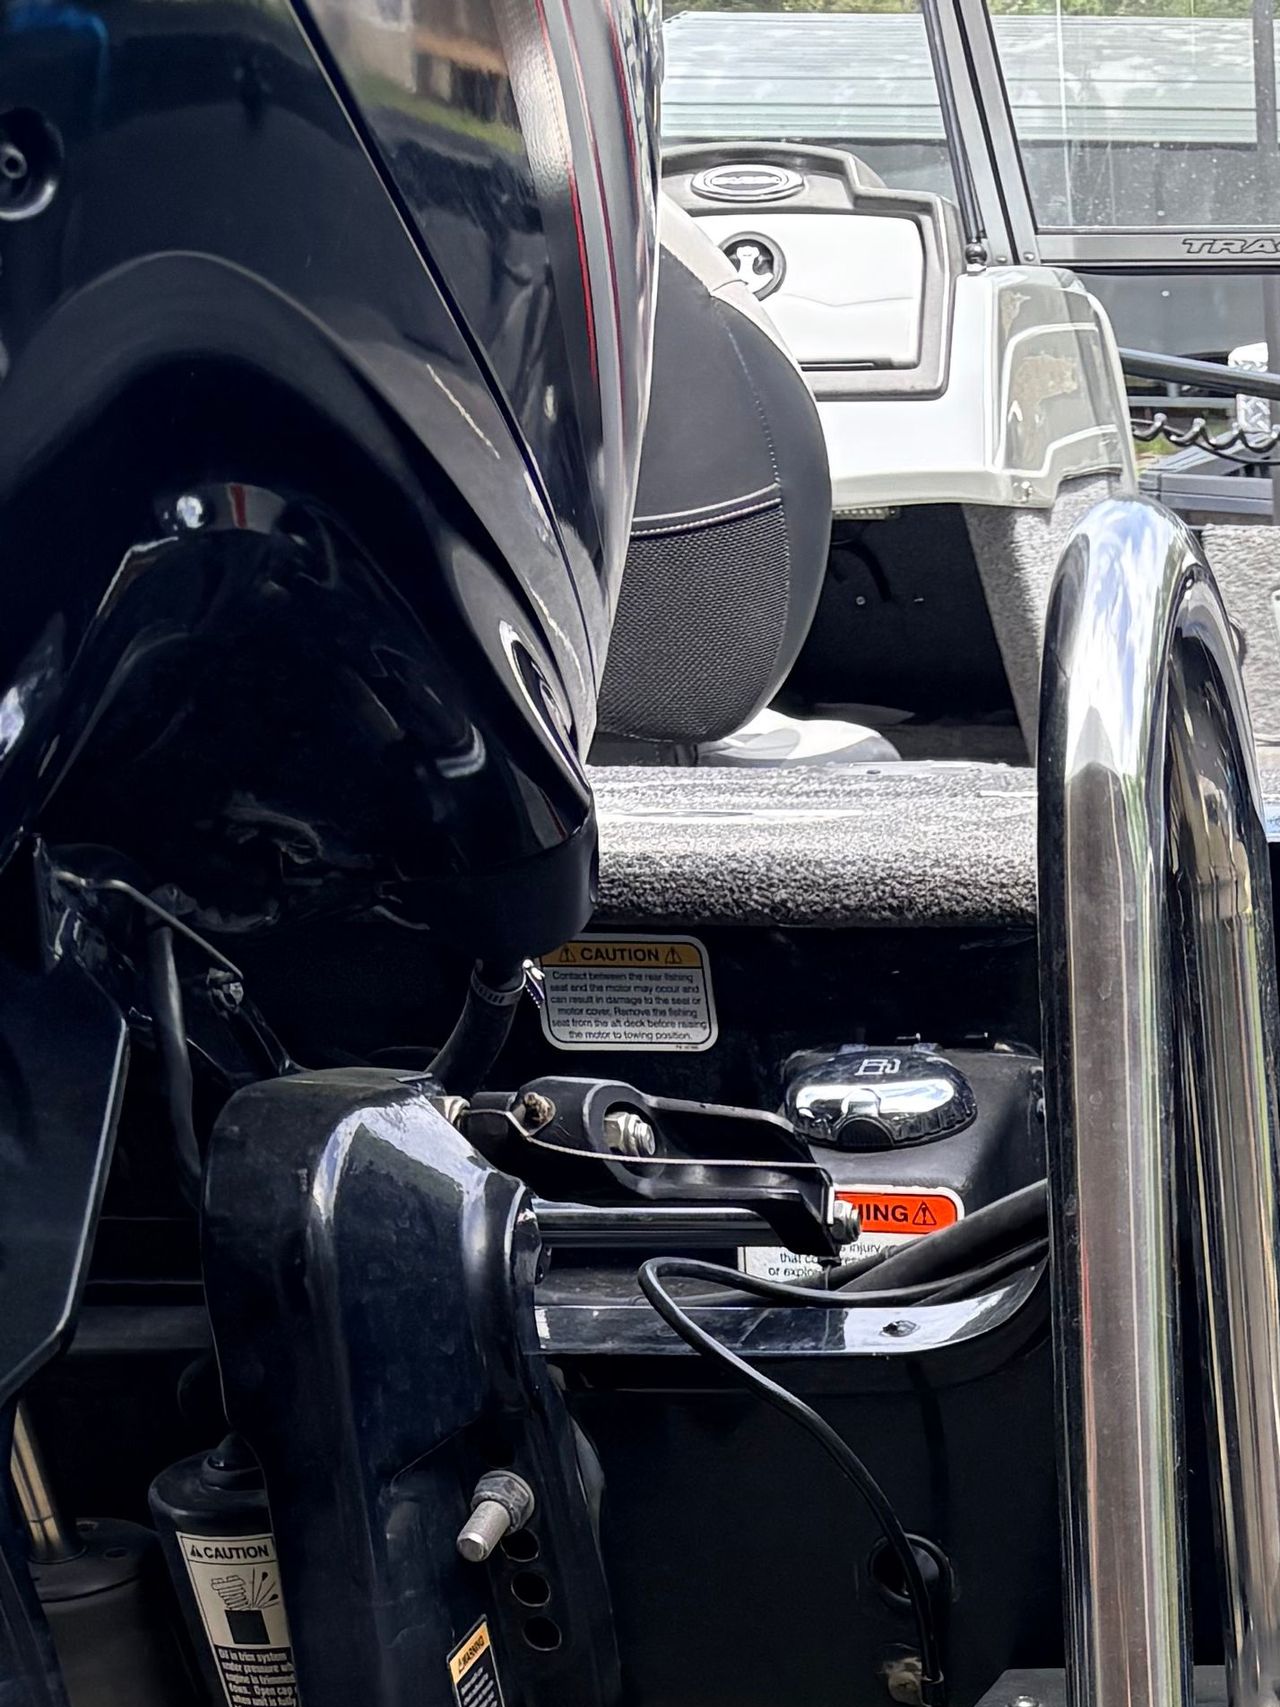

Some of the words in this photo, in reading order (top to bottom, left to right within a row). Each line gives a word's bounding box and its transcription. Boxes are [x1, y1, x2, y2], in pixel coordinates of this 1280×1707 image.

[580, 947, 659, 962] CAUTION
[557, 1007, 583, 1015] motor
[614, 1007, 649, 1016] Remove
[652, 1008, 666, 1017] the
[572, 1019, 592, 1027] from
[594, 1020, 608, 1028] the
[624, 1020, 645, 1028] deck
[648, 1020, 675, 1028] before
[569, 1030, 583, 1038] the
[585, 1031, 610, 1039] motor
[612, 1031, 621, 1039] to
[624, 1031, 652, 1041] towing
[203, 1545, 269, 1559] CAUTION
[254, 1686, 275, 1700] Open
